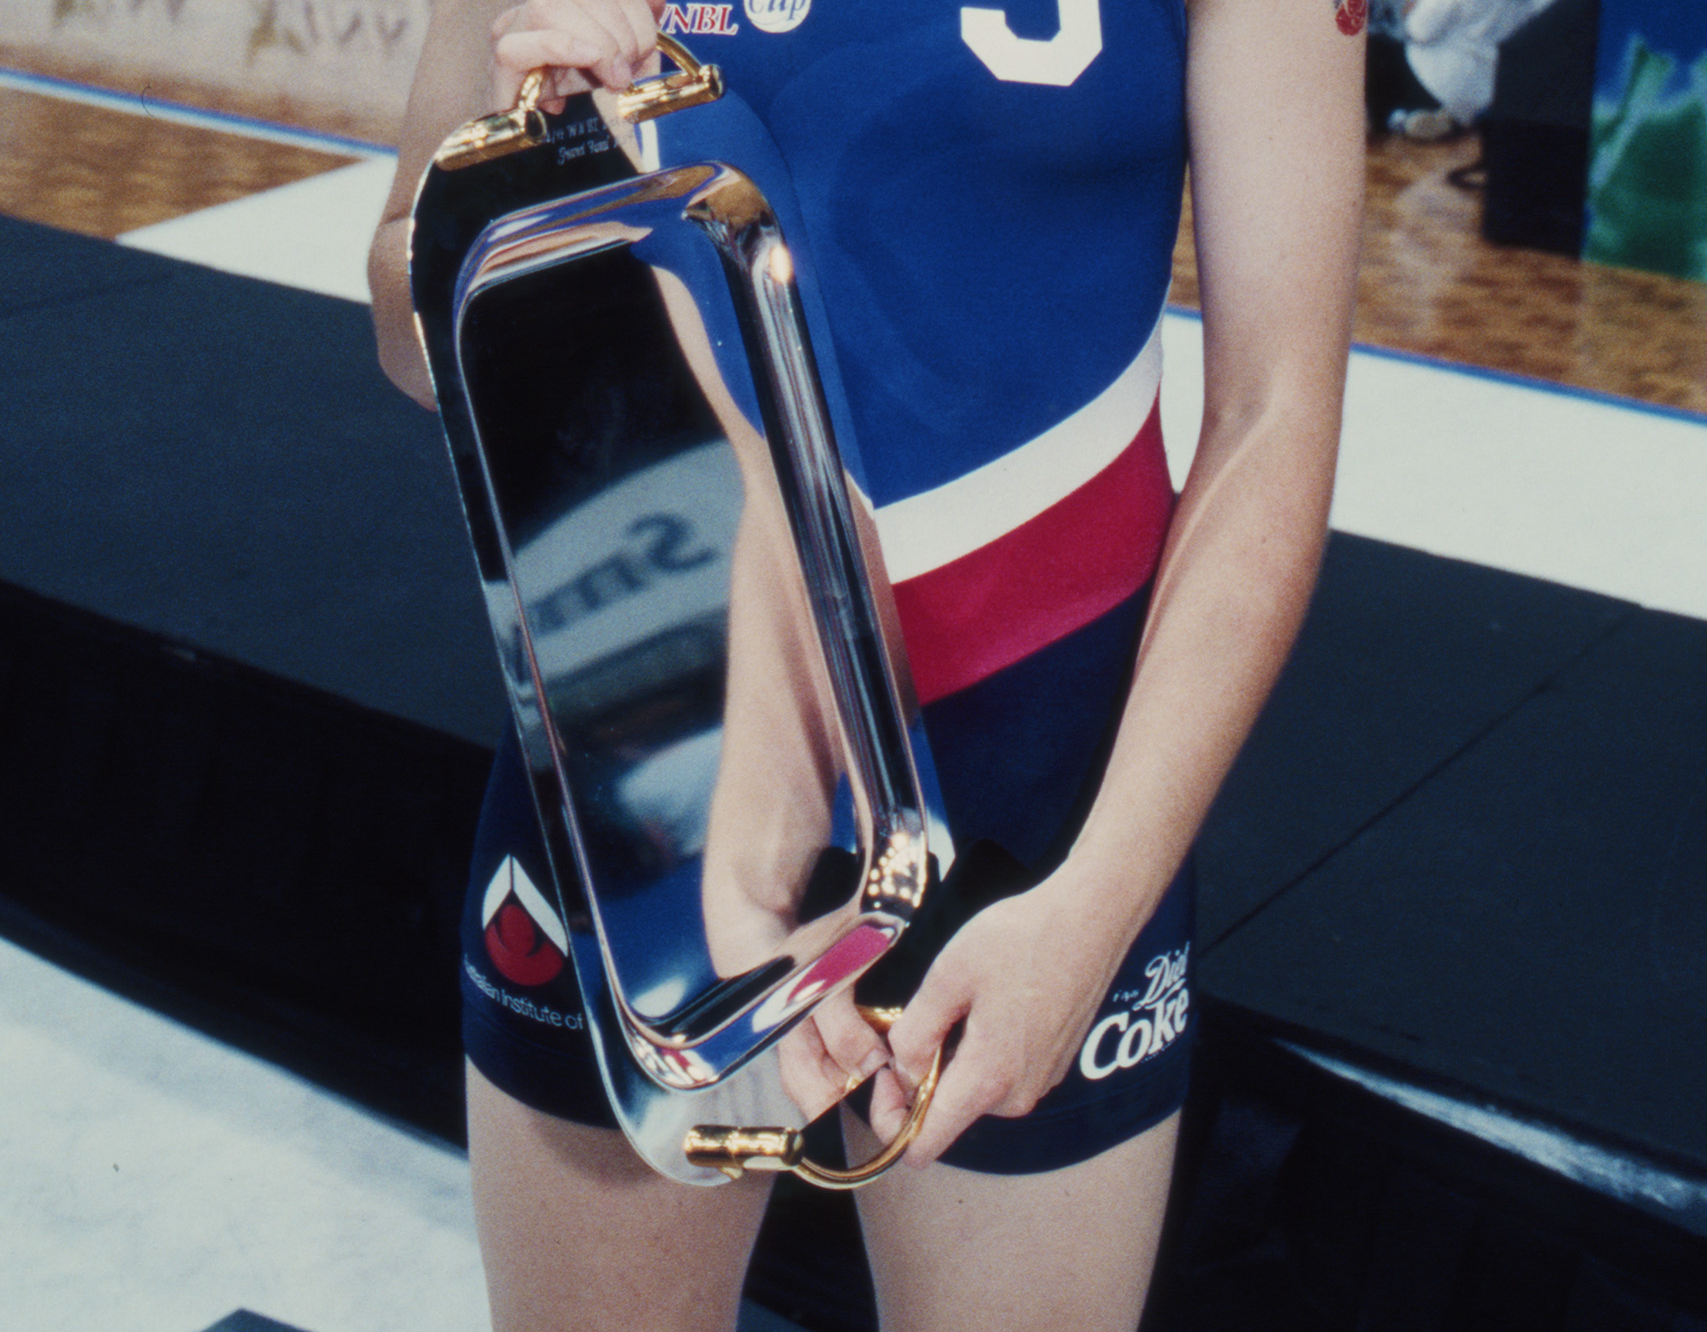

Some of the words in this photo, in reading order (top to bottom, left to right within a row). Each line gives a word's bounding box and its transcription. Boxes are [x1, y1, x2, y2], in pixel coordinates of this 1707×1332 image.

[501, 988, 563, 1027] Institute
[564, 1012, 584, 1030] of
[1079, 987, 1190, 1080] Coke
